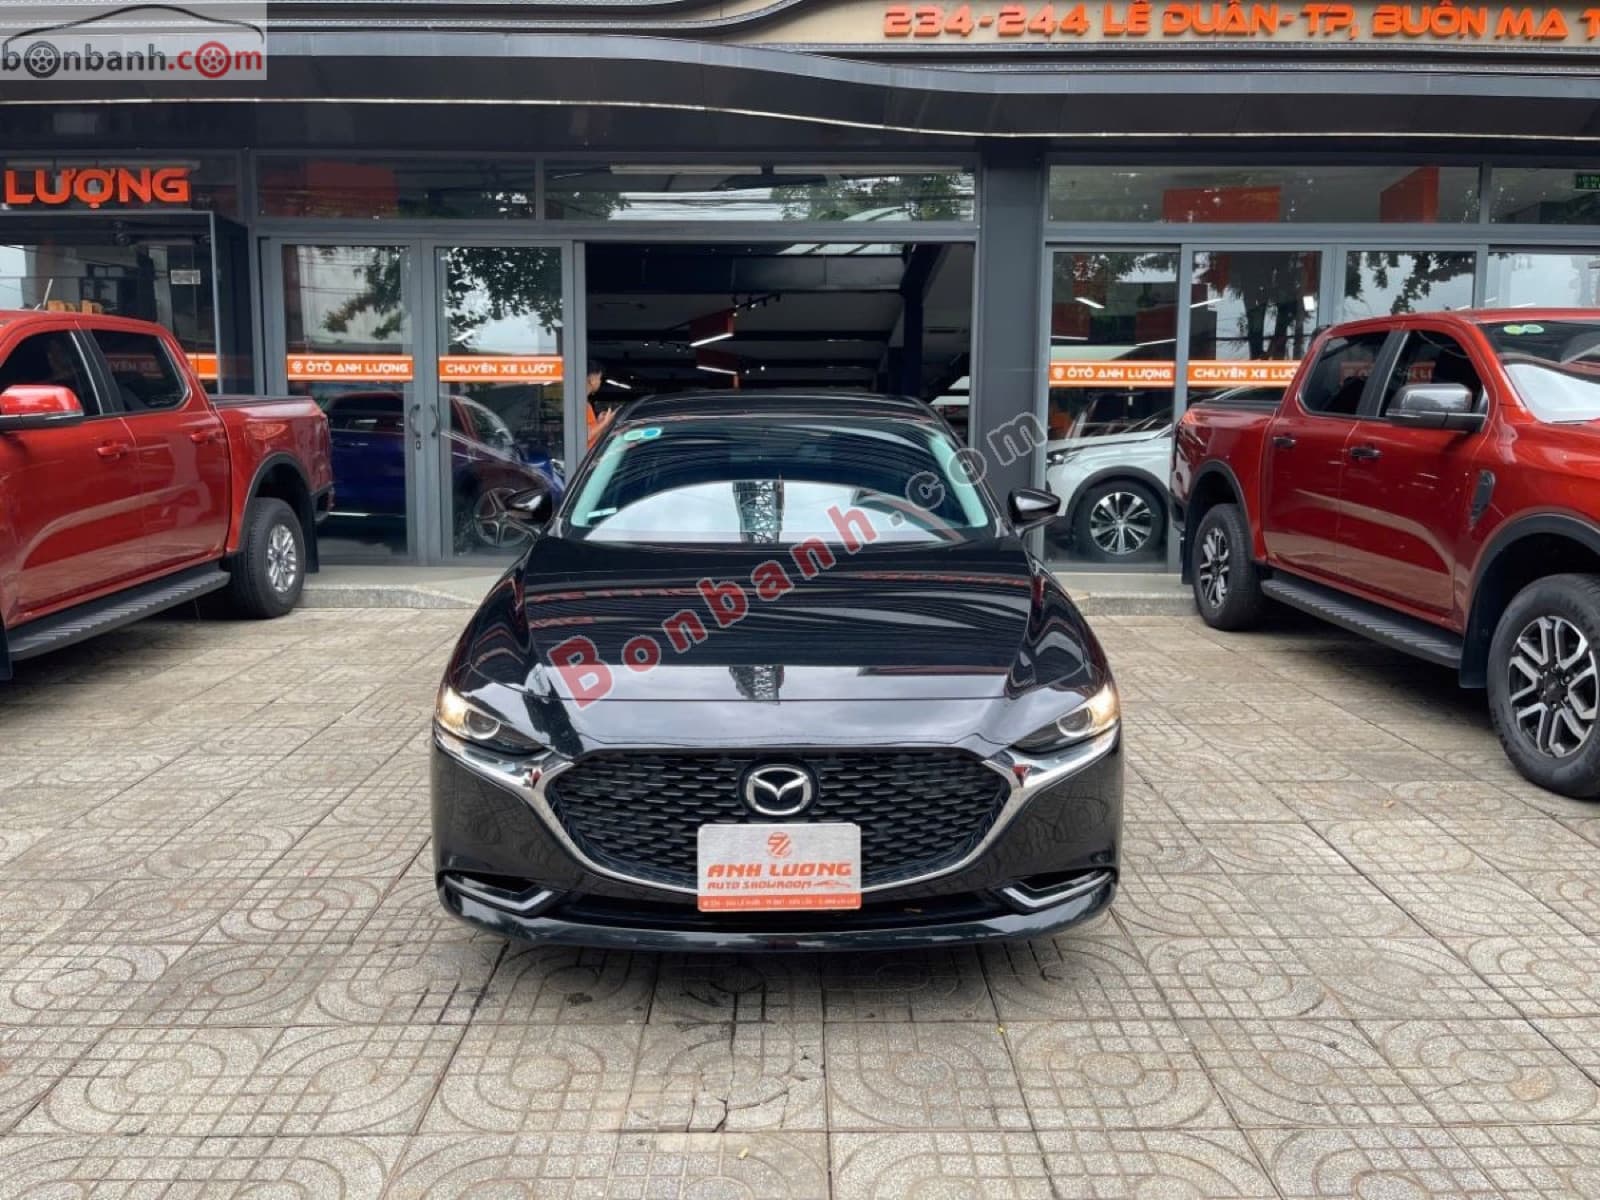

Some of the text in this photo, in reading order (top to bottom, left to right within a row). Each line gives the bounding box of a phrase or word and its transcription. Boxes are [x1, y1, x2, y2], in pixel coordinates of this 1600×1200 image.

[1101, 0, 1152, 34] LÊ
[1373, 2, 1489, 37] BUÔN
[1496, 9, 1571, 39] MA
[4, 168, 190, 208] LƯỢNG
[335, 364, 362, 373] ANH
[445, 363, 497, 374] CHUYÊN
[501, 364, 518, 374] XE
[1097, 368, 1124, 378] ANH
[1194, 367, 1247, 378] CHUYÊN
[1251, 368, 1268, 378] XE
[706, 863, 763, 878] ANH
[706, 879, 813, 890] AUTO SHOWROOM
